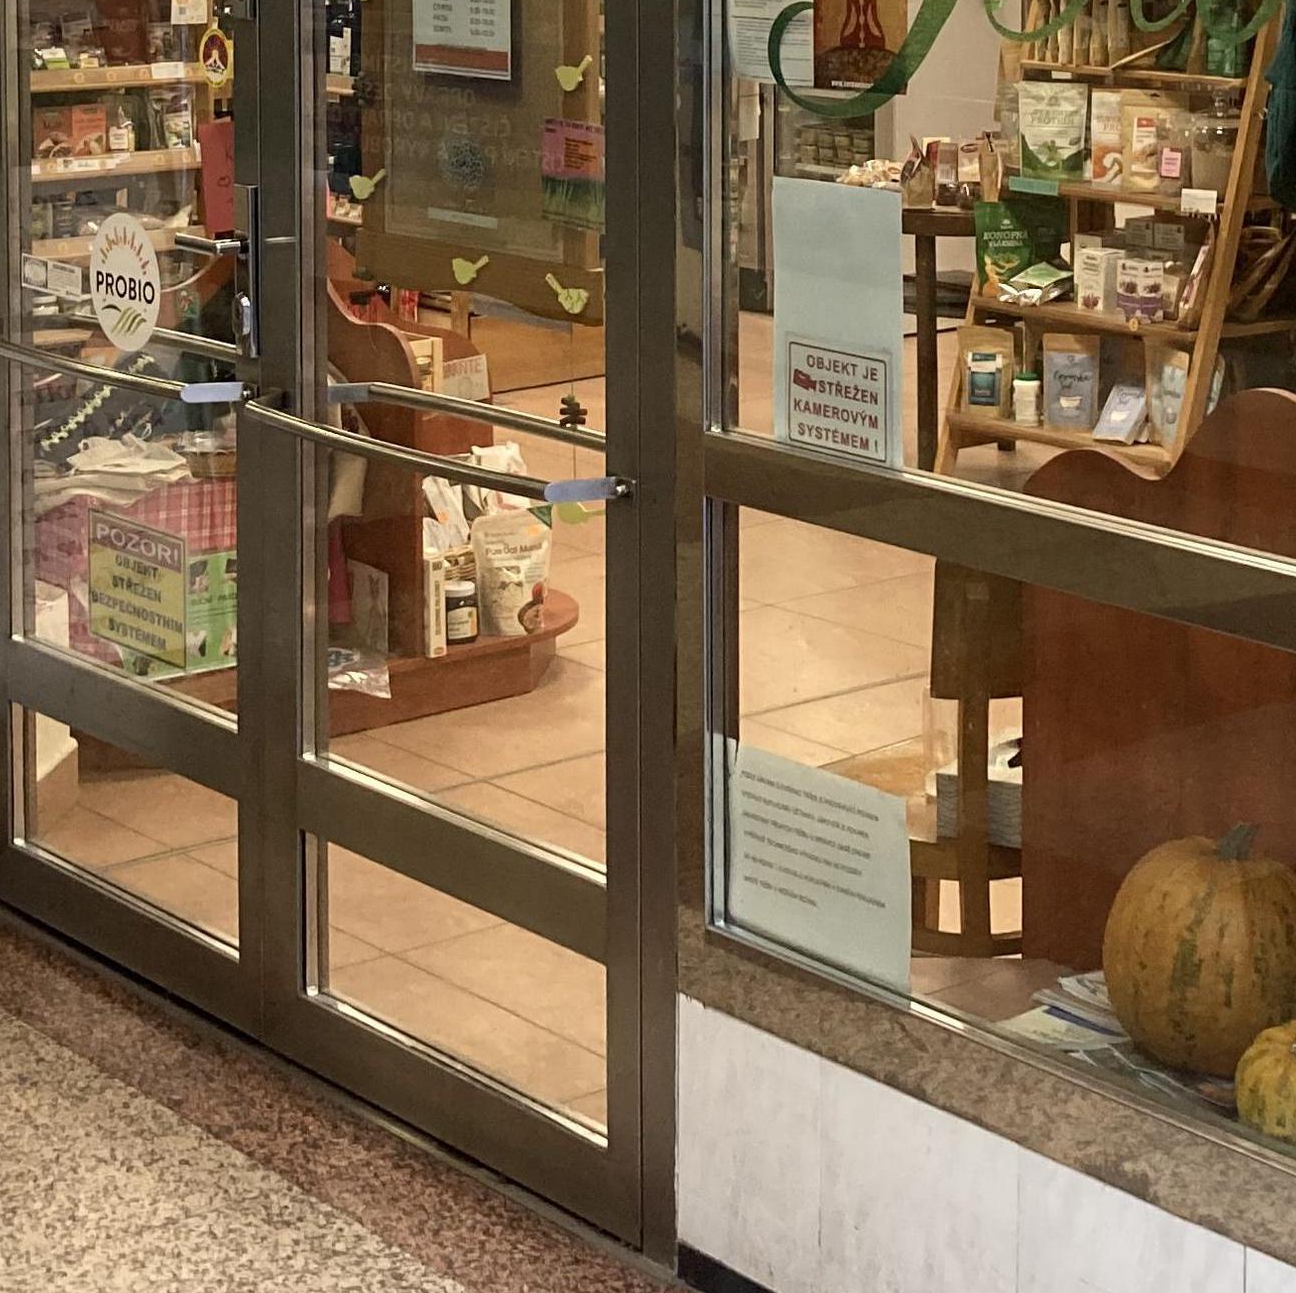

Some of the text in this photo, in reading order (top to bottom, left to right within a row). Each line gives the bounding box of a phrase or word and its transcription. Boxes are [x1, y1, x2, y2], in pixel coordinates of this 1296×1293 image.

[96, 270, 155, 305] PROBIO
[806, 354, 879, 382] OBJEKT JE
[818, 379, 879, 406] STŘEŽEN
[793, 397, 879, 430] KAMEROVÝM
[96, 522, 179, 564] POZOR!
